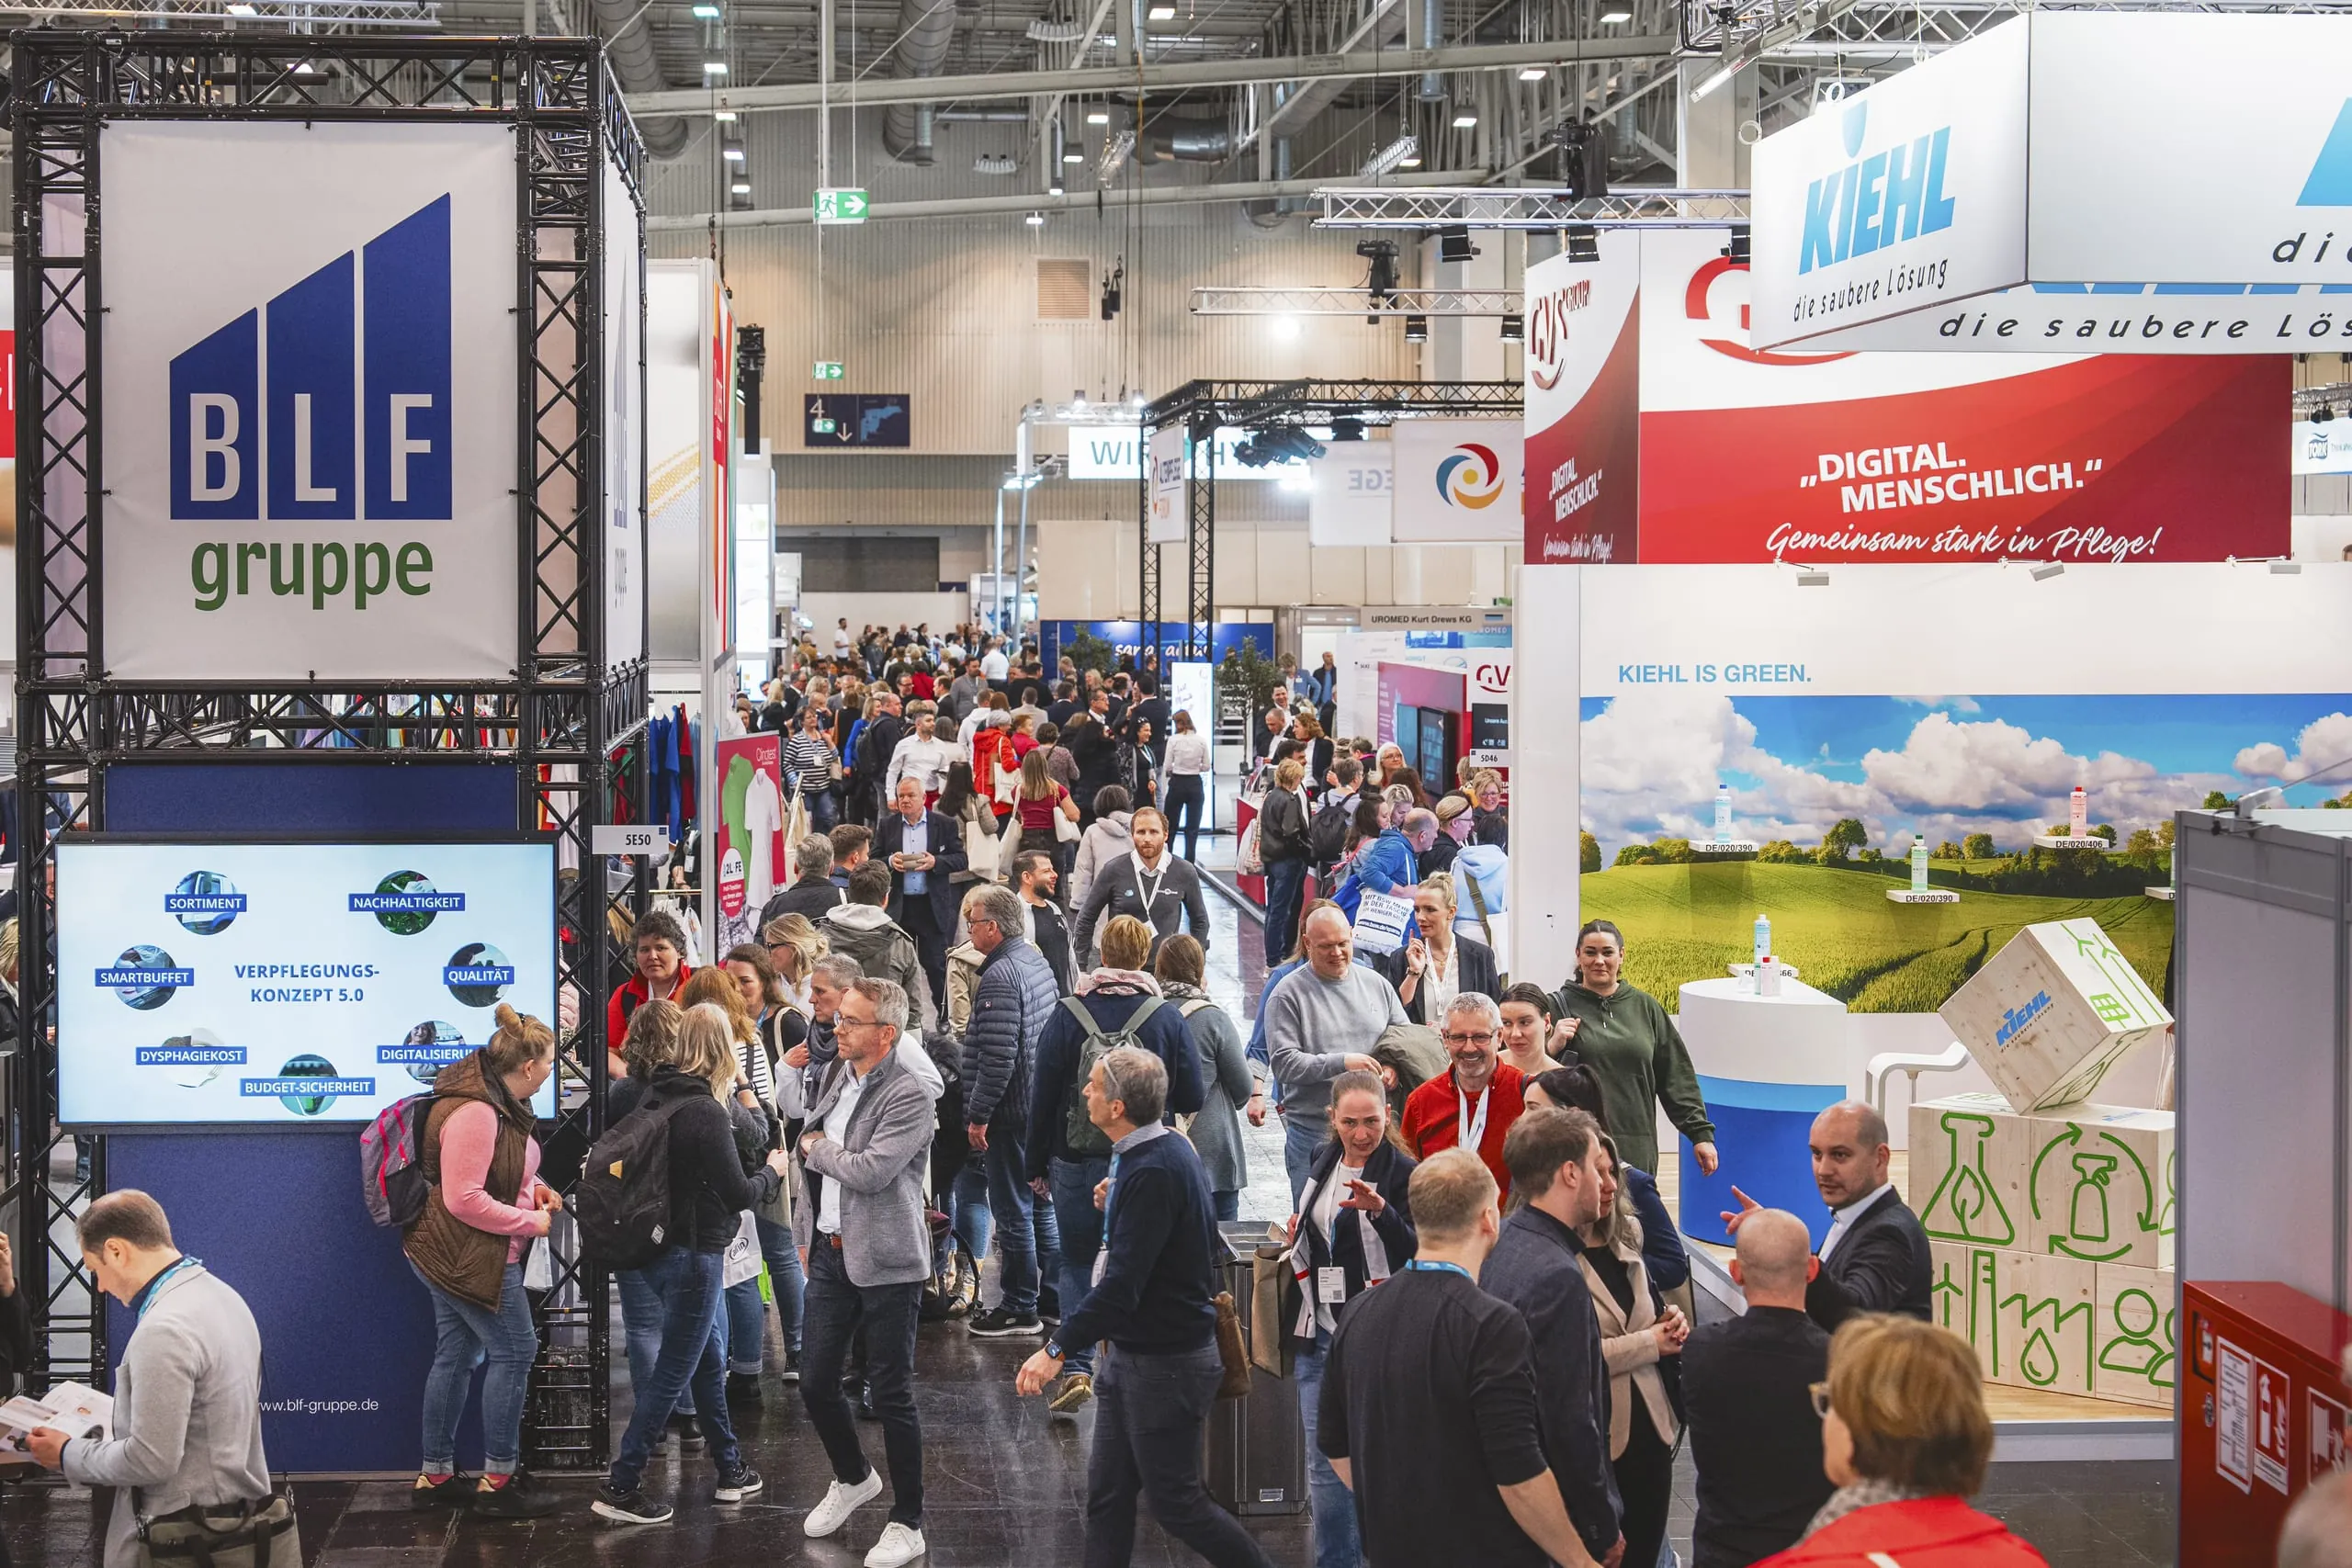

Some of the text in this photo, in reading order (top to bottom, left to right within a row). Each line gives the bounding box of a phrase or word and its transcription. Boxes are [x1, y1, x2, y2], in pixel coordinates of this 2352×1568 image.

[1798, 125, 1956, 276] KIEHL
[1793, 258, 1949, 322] die saubere Lösung
[1939, 311, 2352, 339] die saubere Lös
[809, 398, 825, 419] 4
[189, 393, 433, 502] BLF
[1091, 441, 1142, 465] WI
[1766, 522, 2163, 564] Gemeinsam stark in Pflege!
[190, 541, 434, 611] gruppe
[1371, 615, 1473, 624] UROMED Kurt Drews KG
[1476, 664, 1510, 686] GV
[1618, 663, 1813, 683] KIEHL IS GREEN.
[1480, 754, 1498, 763] 5D46
[625, 833, 652, 847] 5E50
[1705, 843, 1753, 852] DE/020/390
[2055, 840, 2103, 849] DE/020/406
[169, 897, 243, 911] SORTIMENT
[353, 897, 461, 910] NACHHALTIGKEIT
[1905, 894, 1953, 903] DE/020/390
[100, 972, 189, 985] SMARTBUFFET
[234, 964, 380, 980] VERPFLEGUNGS-
[447, 967, 510, 984] QUALITÄT
[251, 988, 365, 1003] KONZEPT 5.0
[1996, 989, 2052, 1047] KIEHL
[140, 1049, 243, 1064] DYSPHAGIEKOST
[381, 1048, 476, 1063] DIGITALISIERU
[244, 1080, 371, 1095] BUDGET-SICHERHEIT
[258, 1398, 379, 1415] ww.blf-gruppe.de
